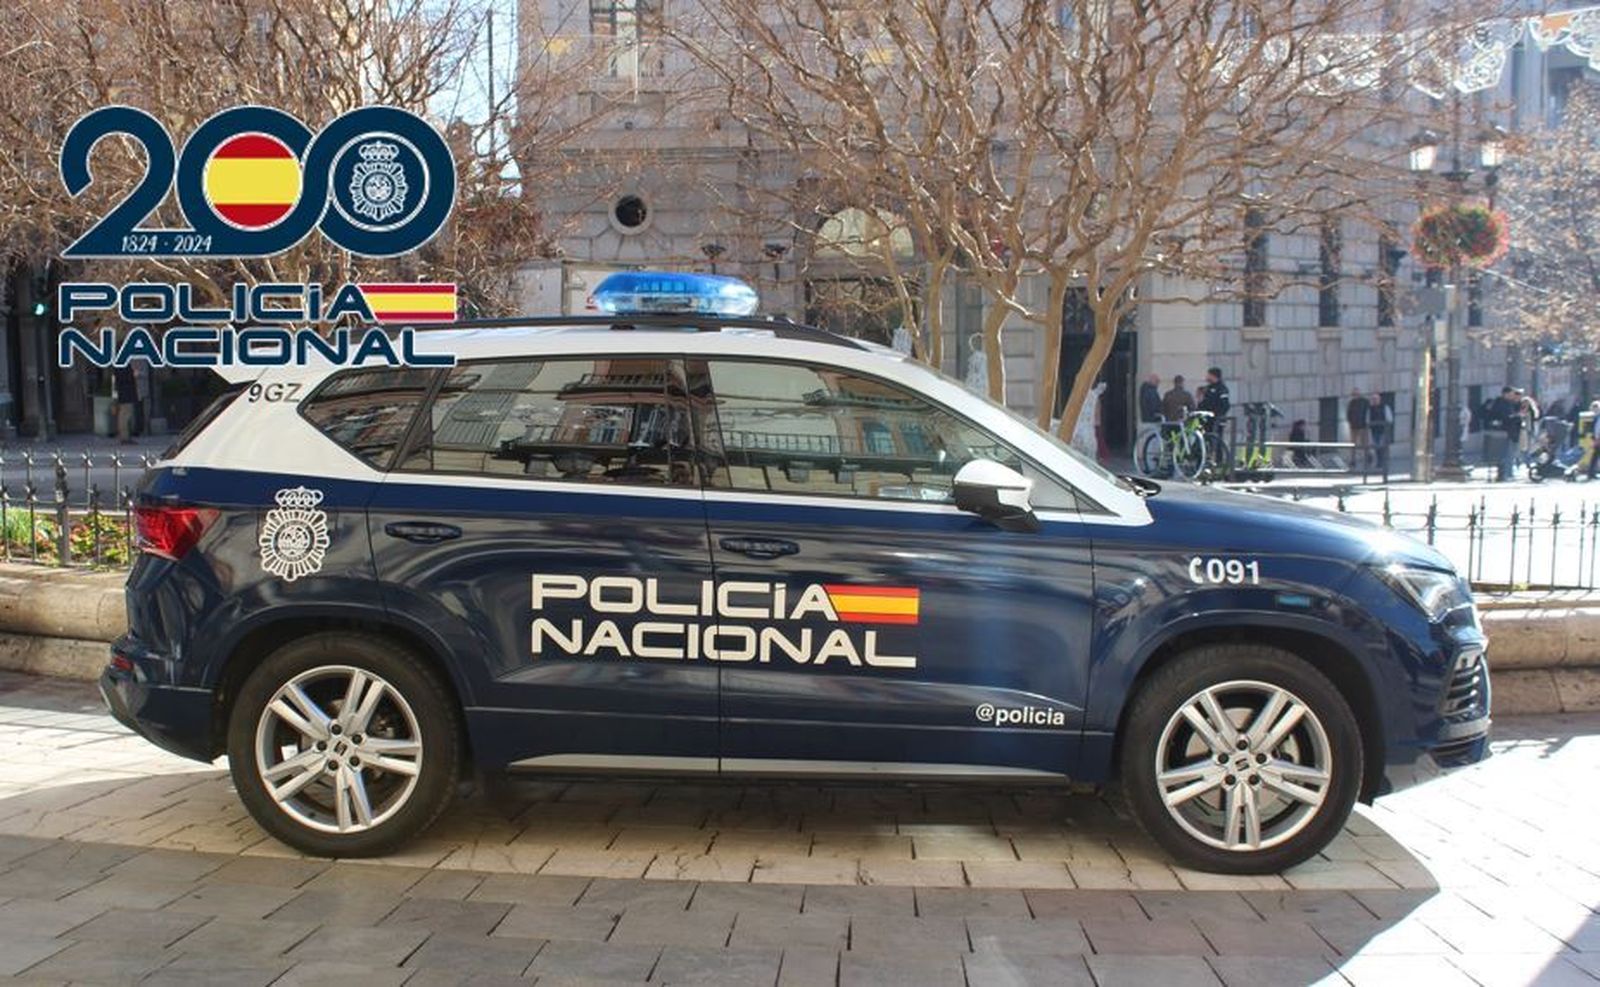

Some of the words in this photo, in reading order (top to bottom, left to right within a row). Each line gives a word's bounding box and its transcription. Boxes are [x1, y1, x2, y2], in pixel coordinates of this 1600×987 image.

[248, 382, 303, 403] 9GZ
[531, 617, 918, 669] NACIONAL
[975, 703, 1066, 727] @policia
